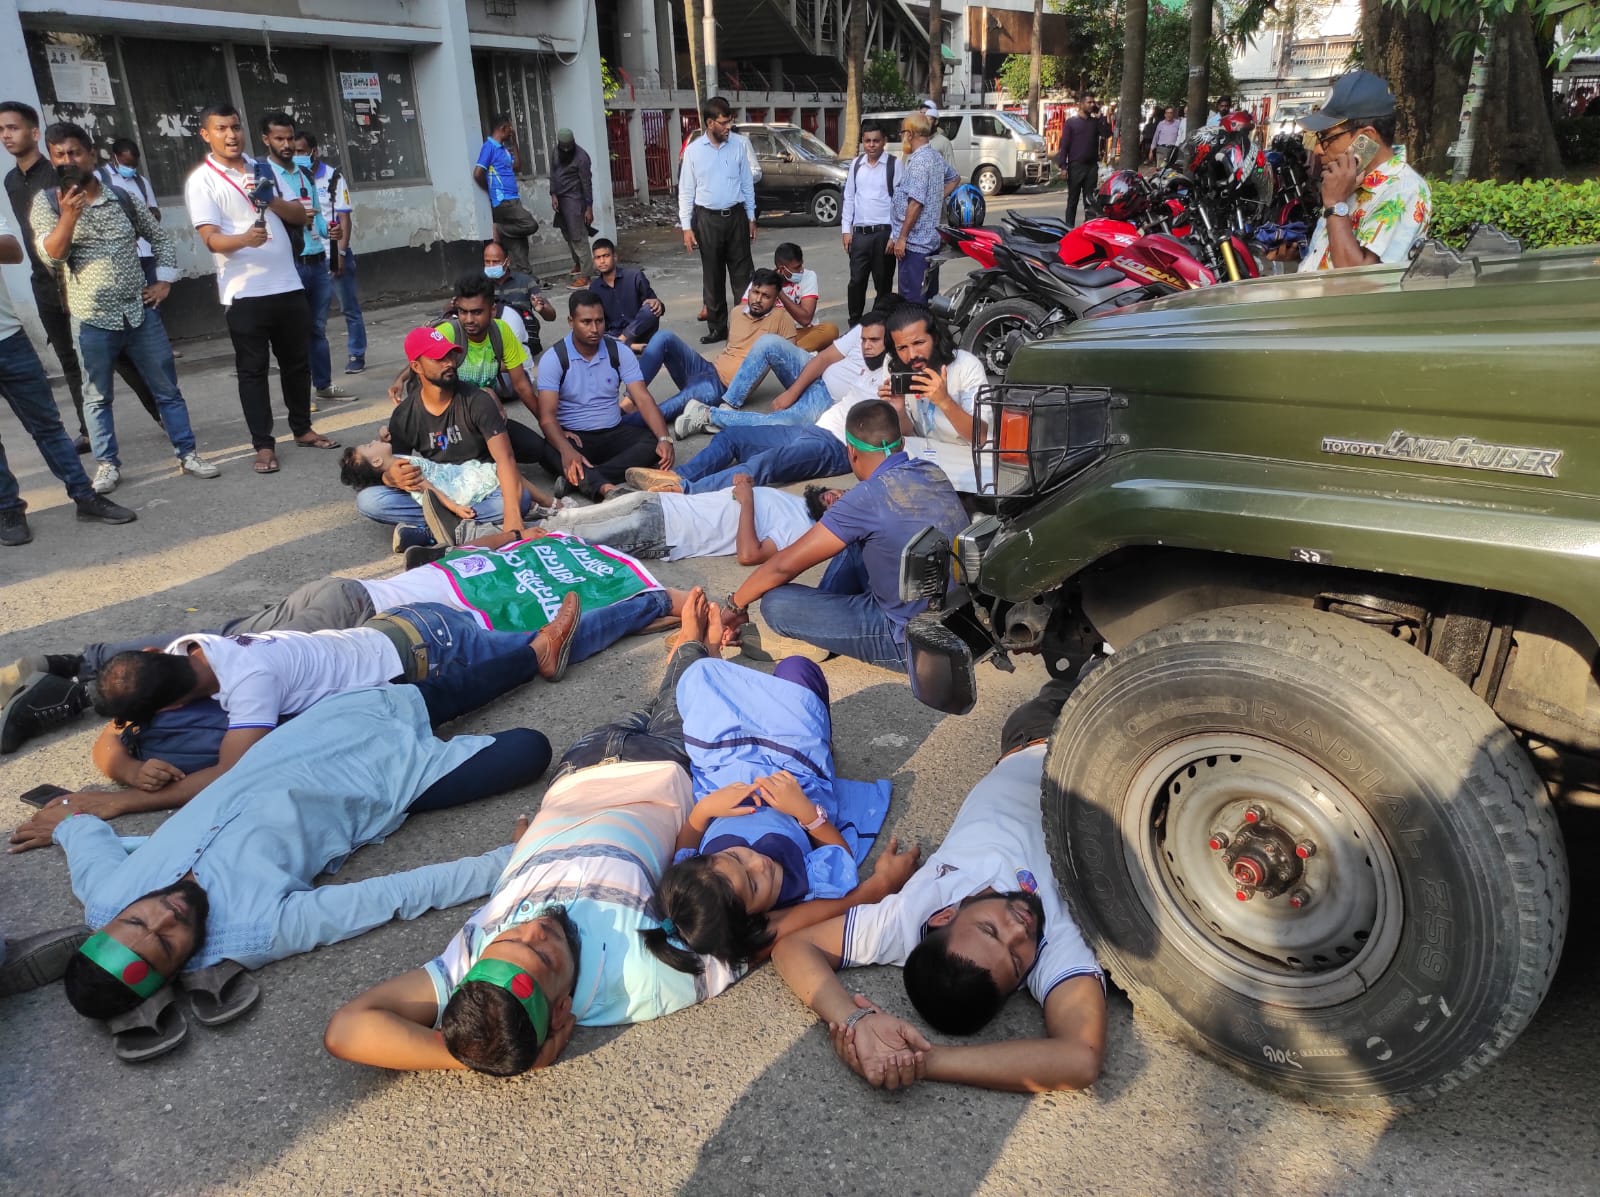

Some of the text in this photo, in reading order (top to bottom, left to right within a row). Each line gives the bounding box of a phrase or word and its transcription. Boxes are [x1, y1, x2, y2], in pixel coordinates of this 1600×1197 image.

[1322, 440, 1378, 456] TOYOTA
[566, 547, 614, 577] কামনা
[1252, 698, 1431, 862] RADIAL
